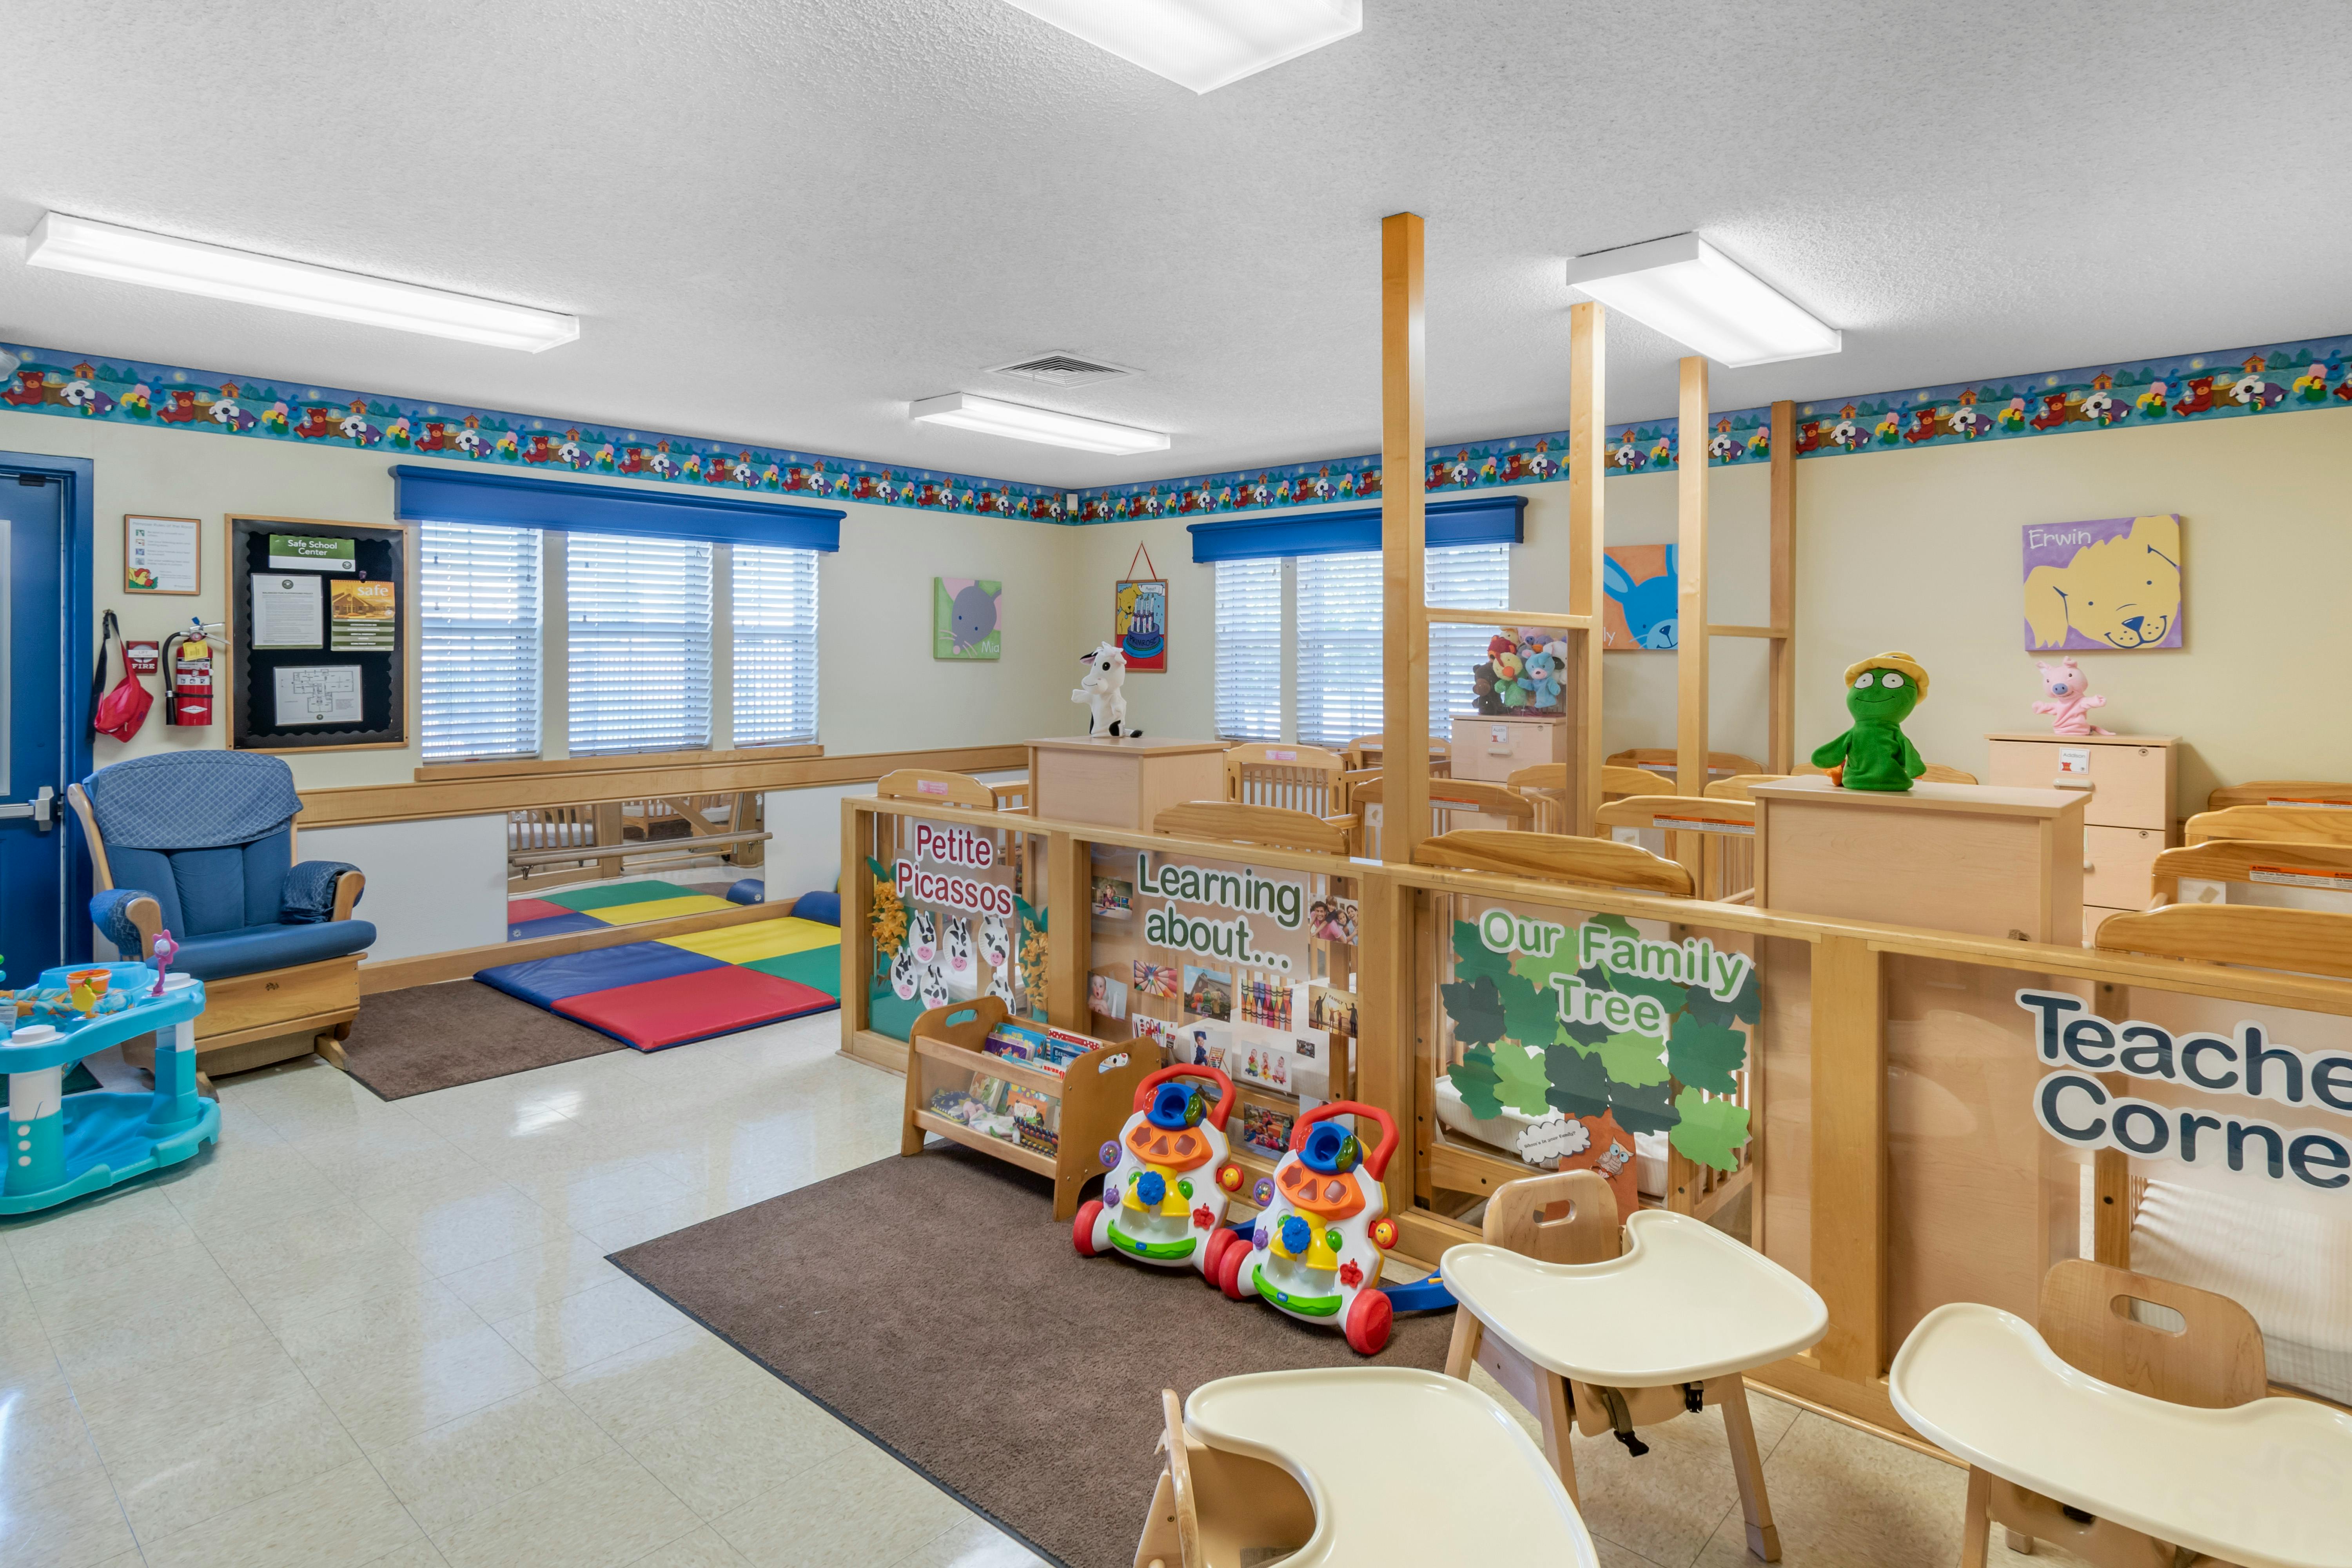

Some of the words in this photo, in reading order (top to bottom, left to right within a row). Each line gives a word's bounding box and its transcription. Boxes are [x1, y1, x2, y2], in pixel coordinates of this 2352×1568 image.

[288, 539, 307, 548] Safe
[309, 541, 338, 549] School
[2028, 529, 2091, 549] Erwin
[357, 584, 388, 596] safe
[981, 640, 1000, 653] Mia
[916, 824, 991, 866] Petite
[898, 862, 1011, 915] Picassos
[1140, 854, 1301, 928] Learning
[1147, 907, 1289, 969] about...
[1483, 911, 1561, 953] Our
[1583, 926, 1743, 997] Family
[1328, 995, 1344, 1005] FAMILY
[1553, 977, 1661, 1032] Tree
[1017, 1103, 1035, 1116] HUMPTY
